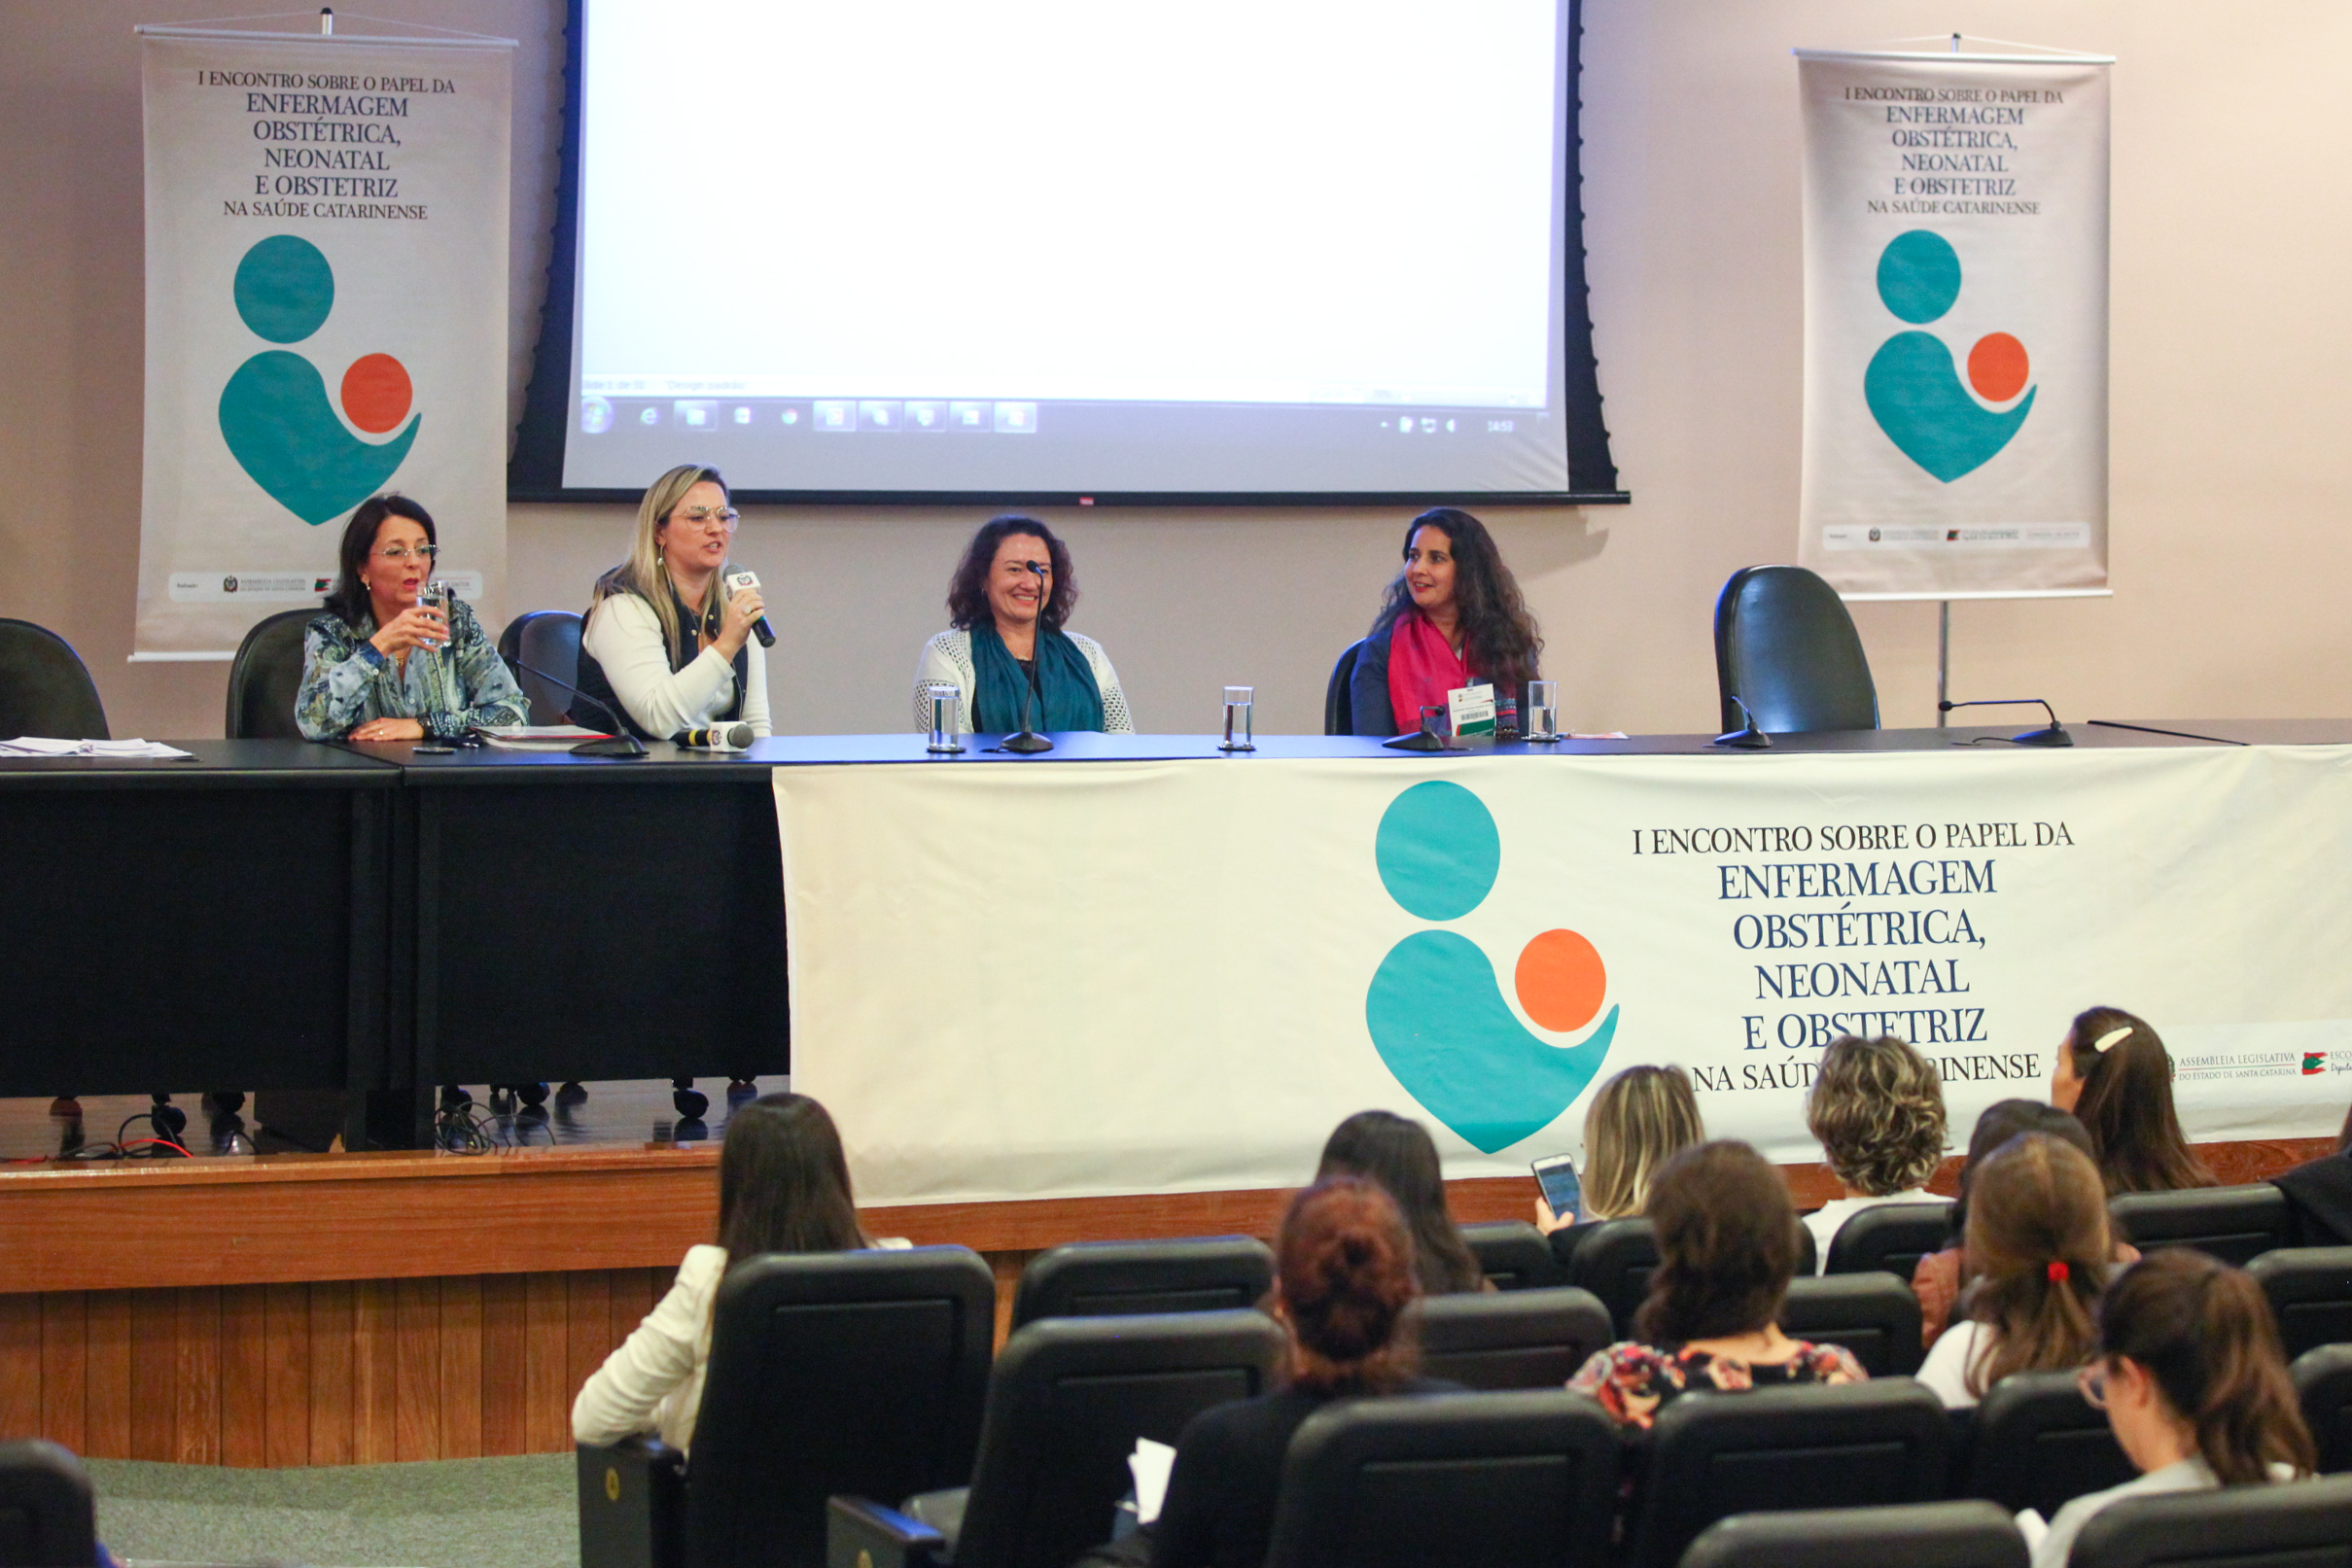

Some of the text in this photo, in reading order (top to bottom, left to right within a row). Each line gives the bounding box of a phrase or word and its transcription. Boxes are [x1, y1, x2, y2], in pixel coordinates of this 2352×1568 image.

[198, 71, 456, 93] I ENCONTRO SOBRE O PAPEL DA
[246, 92, 409, 118] ENFERMAGEM
[1845, 87, 2064, 104] I ENCONTRO SOBRE O PAPEL DA
[1885, 106, 2023, 125] ENFERMAGEM
[253, 117, 401, 148] OBSTÉTRICA,
[1892, 125, 2019, 151] OBSTÉTRICA,
[263, 148, 390, 170] NEONATAL
[1901, 154, 2008, 172] NEONATAL
[255, 175, 399, 197] E OBSTETRIZ
[1894, 177, 2016, 196] E OBSTETRIZ
[224, 197, 429, 220] NA SAÚDE CATARINENSE
[1867, 196, 2041, 216] NA SAÚDE CATARINENSE
[1632, 821, 2075, 854] I ENCONTRO SOBRE O PAPEL DA
[1717, 859, 1997, 900] ENFERMAGEM
[1733, 901, 1985, 950] OBSTÉTRICA,
[1754, 959, 1970, 999] NEONATAL
[1741, 1008, 1987, 1050] E OBSTETRIZ
[2180, 1053, 2296, 1066] ASSEMBLEIA LEGISLATIVA
[1692, 1054, 2041, 1092] NA SAÚD INENSE
[2260, 1068, 2297, 1077] CATARINA
